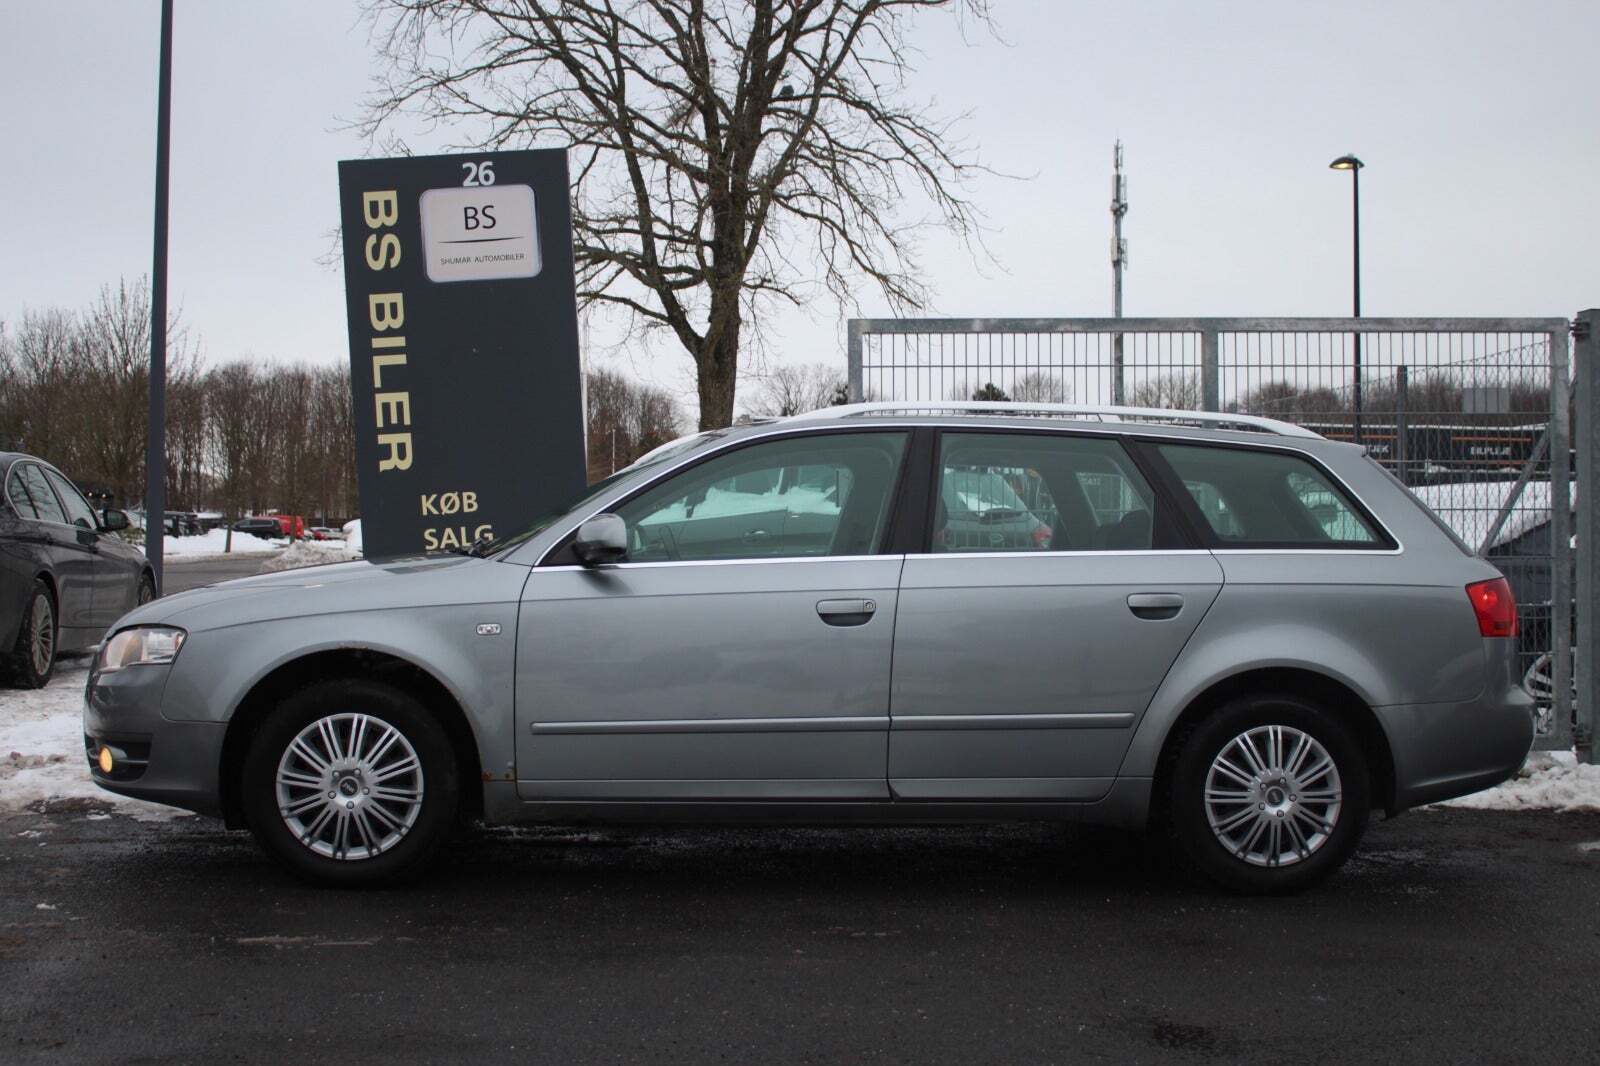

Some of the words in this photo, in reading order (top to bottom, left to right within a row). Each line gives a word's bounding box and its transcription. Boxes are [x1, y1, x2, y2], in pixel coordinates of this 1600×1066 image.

[462, 161, 495, 187] 26
[363, 190, 402, 271] BS
[464, 205, 497, 231] BS
[440, 256, 472, 266] SHUMAR
[474, 252, 525, 264] AUTOMOBILER
[369, 292, 414, 473] BILER
[421, 491, 479, 516] KØB
[423, 524, 494, 551] SALG
